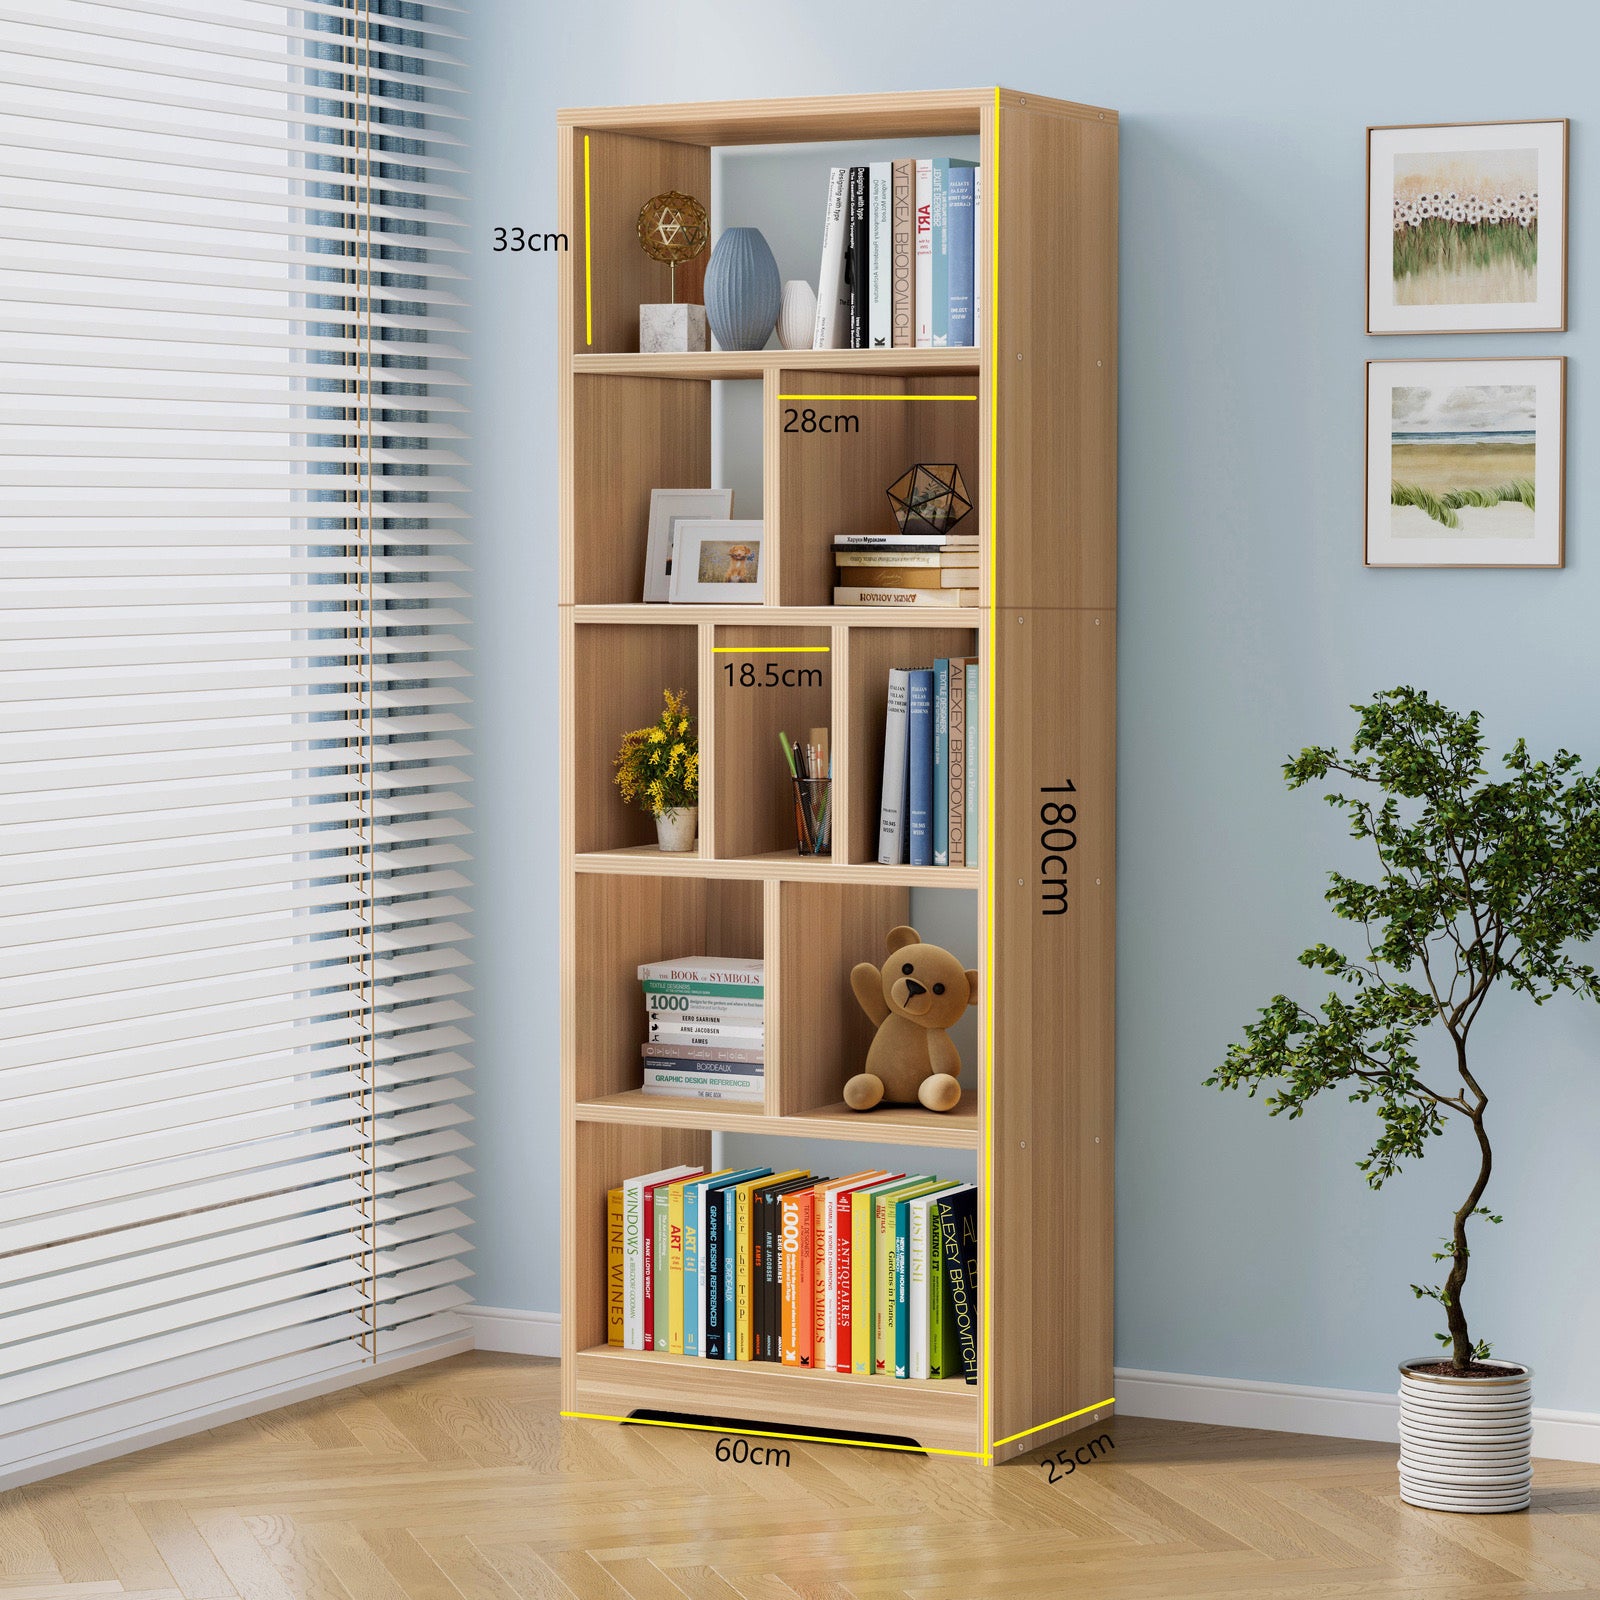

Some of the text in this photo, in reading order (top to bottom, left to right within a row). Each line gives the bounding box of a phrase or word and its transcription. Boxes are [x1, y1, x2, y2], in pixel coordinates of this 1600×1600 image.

[836, 170, 845, 196] Designing
[856, 168, 864, 195] Designing
[856, 208, 864, 220] type
[951, 664, 962, 854] ALEXEY BRODOVITCH
[671, 970, 698, 980] BOOK
[710, 974, 760, 984] SYMBOLS
[650, 995, 689, 1011] 1000
[655, 1075, 750, 1087] GRAPHIC DESIGN REFERENCED
[697, 1063, 731, 1072] BORDEAUX
[612, 1213, 623, 1255] FINE
[627, 1187, 638, 1255] WINDOWS
[783, 1202, 799, 1252] 1000
[670, 1224, 681, 1252] ART
[686, 1225, 696, 1253] ART
[816, 1229, 824, 1265] BOOK
[912, 1206, 923, 1282] LOST FISH
[933, 1260, 939, 1271] IT
[612, 1264, 624, 1325] WINES
[841, 1238, 850, 1327] ANTIQUAIRES
[888, 1288, 895, 1297] in
[939, 1203, 960, 1265] ALEXEY
[950, 1269, 976, 1372] BRODOVITCH
[816, 1279, 825, 1343] SYMBOLS
